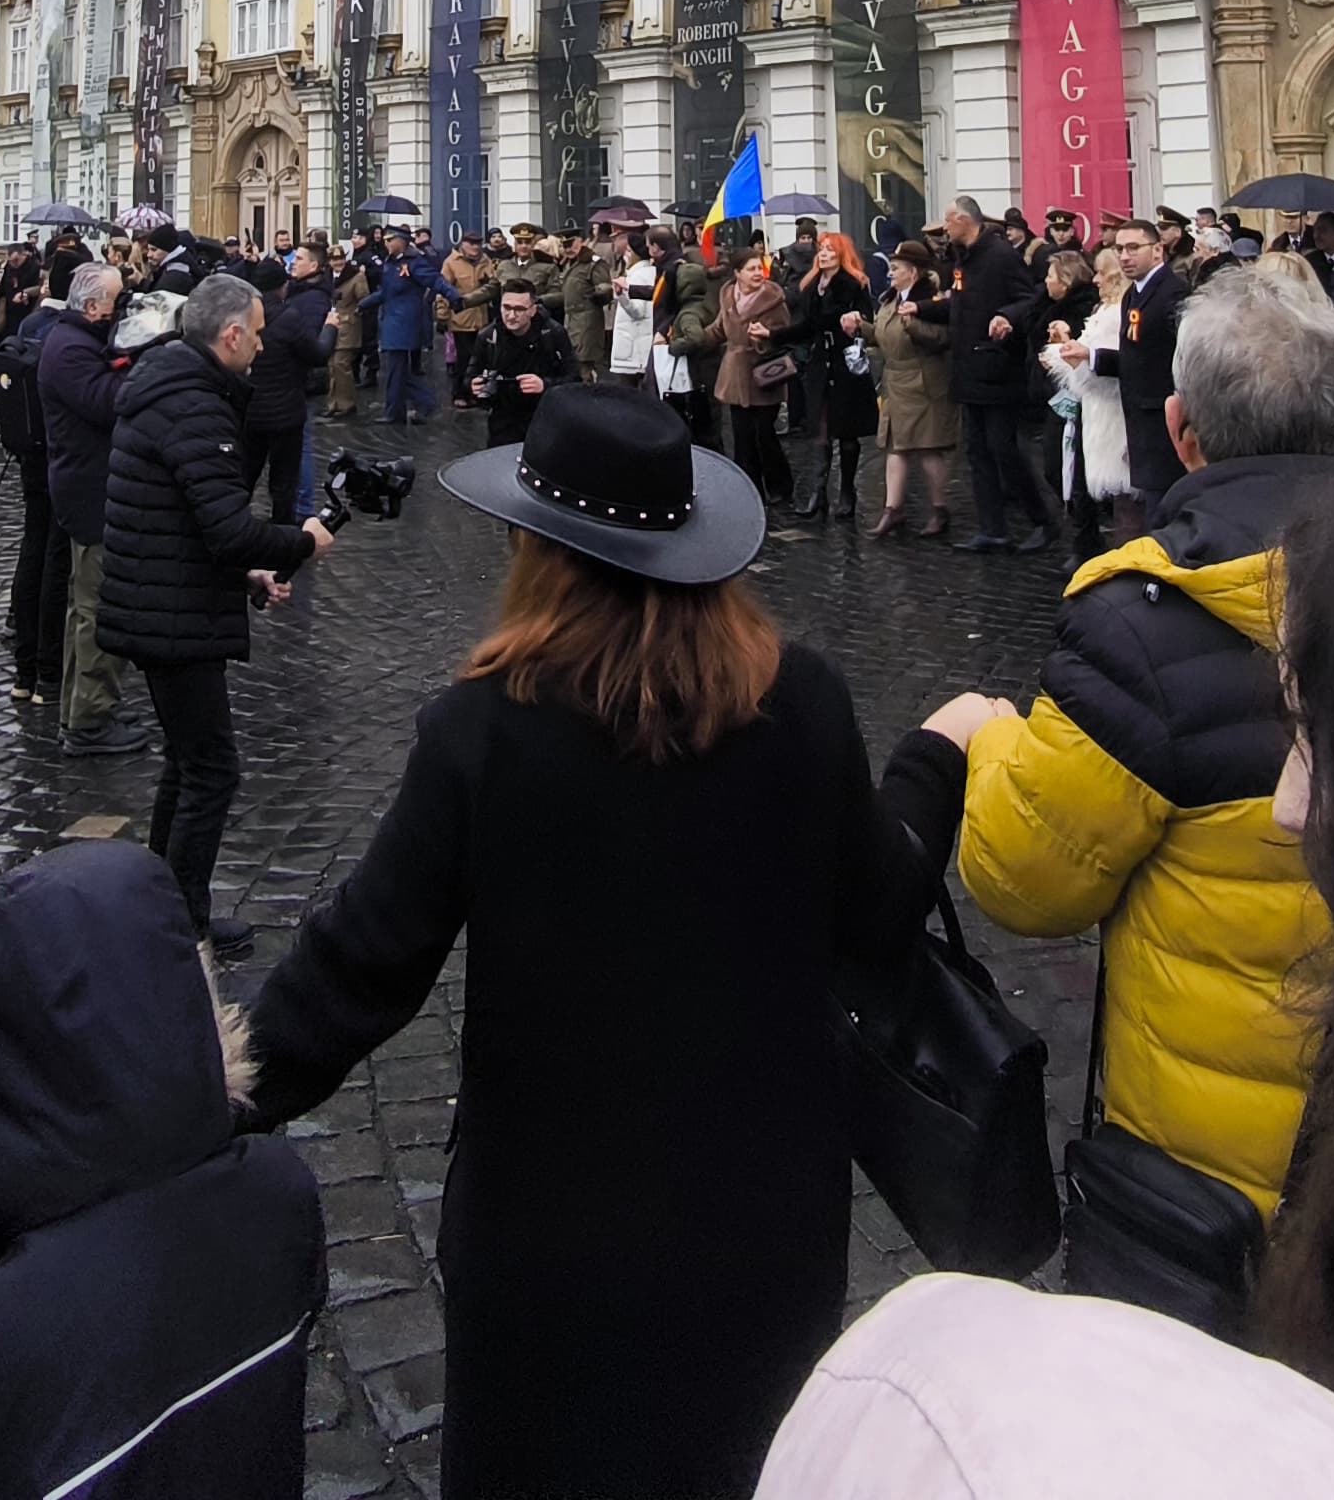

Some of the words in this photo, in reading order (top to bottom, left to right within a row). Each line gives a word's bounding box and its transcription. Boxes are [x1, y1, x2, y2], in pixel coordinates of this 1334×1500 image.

[677, 21, 739, 44] ROBERTO
[682, 45, 733, 67] LONGHI
[342, 57, 351, 124] ROCADA
[355, 97, 365, 117] DE
[355, 125, 364, 180] ANIMA
